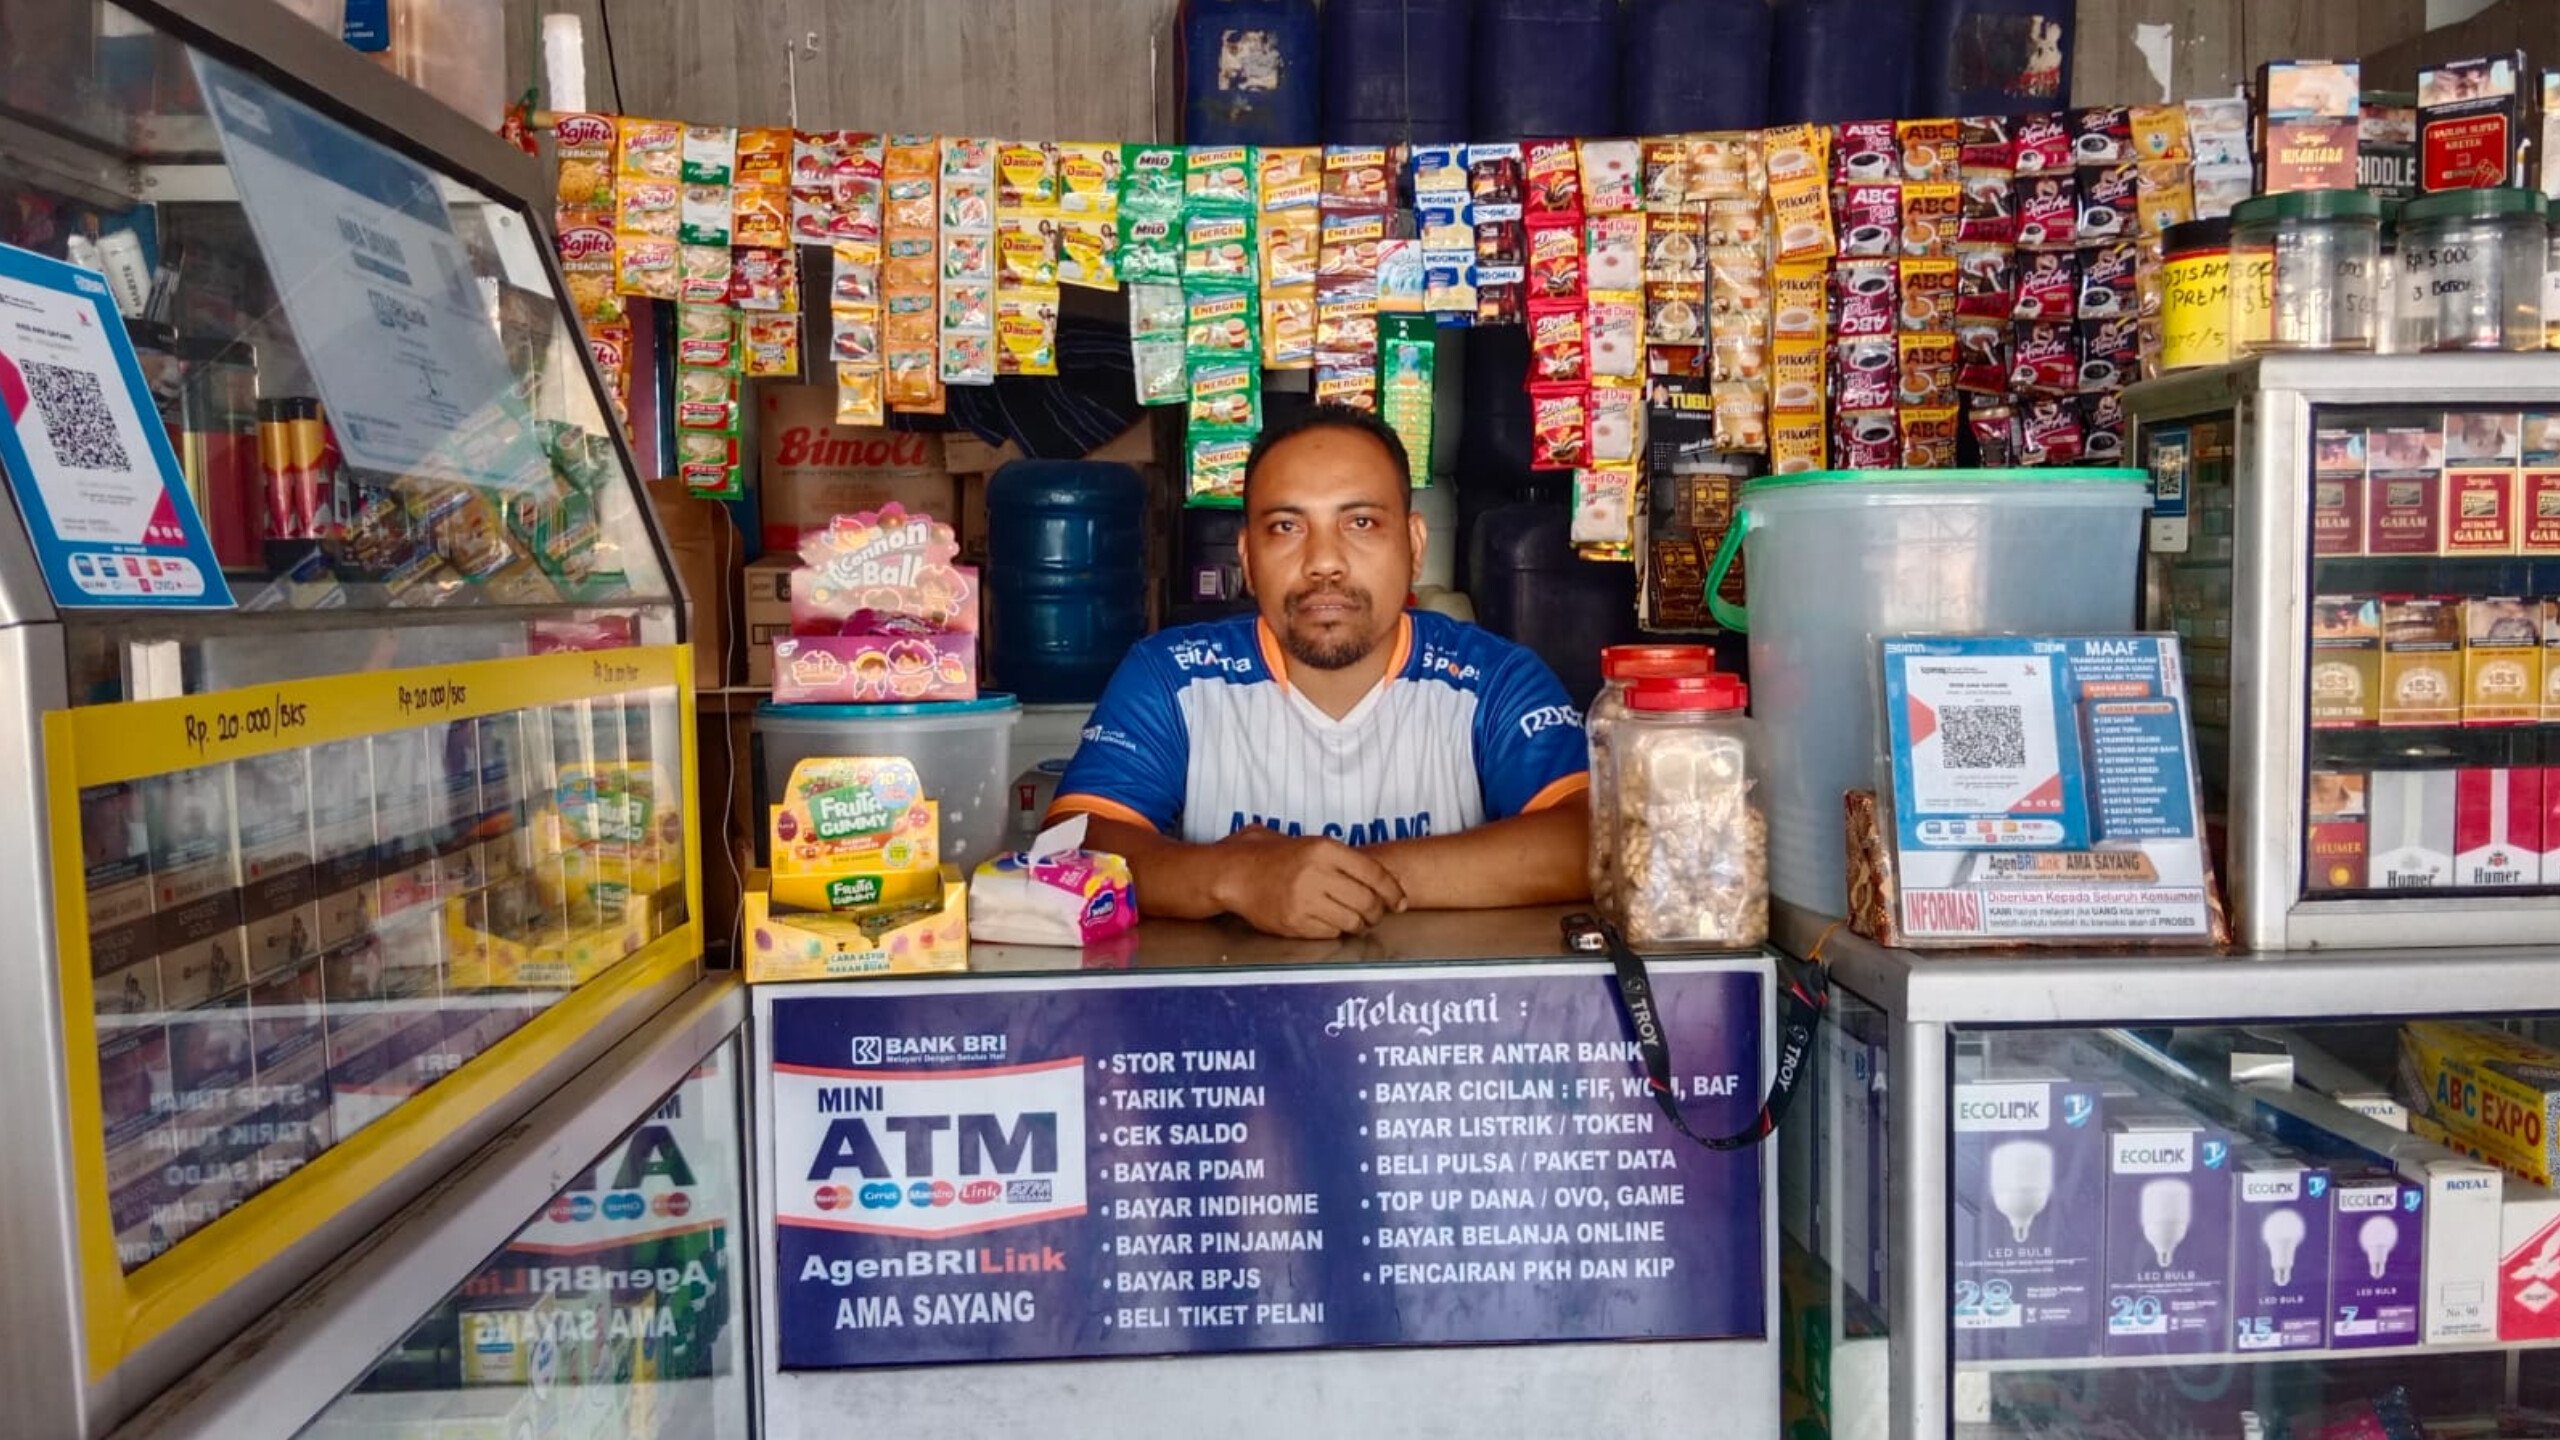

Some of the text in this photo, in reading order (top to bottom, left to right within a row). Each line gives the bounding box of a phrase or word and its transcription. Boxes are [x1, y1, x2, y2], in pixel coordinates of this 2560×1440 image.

[556, 119, 613, 148] Sajiku
[1846, 124, 1890, 136] ABC
[1907, 124, 1955, 141] ABC
[1003, 154, 1045, 168] Dancow
[1139, 154, 1170, 166] MILO
[1192, 150, 1244, 166] ENERGEN
[1330, 152, 1383, 166] ENERGEN
[1421, 195, 1465, 205] INDOMILK
[1853, 188, 1898, 204] ABC
[1908, 198, 1955, 214] ABC
[1135, 223, 1166, 236] MILO
[1192, 225, 1244, 239] ENERGEN
[1326, 224, 1380, 239] ENERGEN
[1616, 221, 1638, 233] Day
[559, 232, 615, 260] Sajiku
[1003, 239, 1045, 253] Dancow
[1426, 255, 1470, 264] INDOMILK
[1907, 273, 1955, 289] ABC
[1193, 301, 1244, 316] ENERGEN
[1324, 302, 1377, 313] ENERGEN
[1613, 306, 1636, 318] Day
[1003, 321, 1044, 336] Dancow
[1905, 347, 1952, 363] ABC
[1195, 375, 1246, 392] ENERGEN
[1905, 421, 1951, 438] ABC
[777, 426, 928, 468] Bimoli
[1605, 475, 1628, 487] Day
[2380, 517, 2428, 528] GARAM
[2454, 530, 2504, 542] GARAM
[863, 553, 924, 587] Ball
[2085, 640, 2140, 657] MAAF
[184, 712, 210, 755] Rp.
[820, 812, 888, 837] GUMMY
[1988, 852, 2141, 875] AgenBRILink AMA SAYANG
[2387, 870, 2437, 888] Humer
[2474, 867, 2521, 884] Humer
[1906, 891, 1980, 932] INFORMASI
[1324, 991, 1500, 1038] Melayani
[1631, 998, 1660, 1048] TROY
[886, 1034, 1007, 1055] BANK BRI
[1374, 1039, 1644, 1067] TRANFER ANTAR BANK
[1113, 1048, 1256, 1075] STOR TUNAI
[1777, 1043, 1801, 1093] TROY
[1113, 1085, 1265, 1111] TARIK TUNAI
[1375, 1080, 1452, 1104] BAYAR
[1460, 1078, 1555, 1102] CICILAN
[1576, 1077, 1616, 1103] FIF,
[1693, 1074, 1740, 1097] BAF
[818, 1086, 884, 1114] MINI
[2437, 1071, 2541, 1147] ABC EXPO
[1960, 1101, 2040, 1120] ECOLINK
[1114, 1122, 1248, 1147] CEK SALDO
[1375, 1112, 1654, 1140] BAYAR LISTRIK TOKEN
[807, 1111, 1059, 1181] ATM
[1377, 1148, 1677, 1177] BELI PULSA PAKET DATA
[2120, 1148, 2185, 1165] ECOLINK
[1115, 1158, 1265, 1184] BAYAR PDAM
[961, 1184, 998, 1200] Link
[2249, 1181, 2295, 1195] ECOLINK
[2446, 1179, 2491, 1192] ROYAL
[1115, 1193, 1320, 1220] BAYAR INDIHOME
[1377, 1183, 1685, 1213] TOP UP DANA OVO, GAME
[2341, 1193, 2394, 1208] ECOLINK
[1116, 1229, 1324, 1257] BAYAR PINJAMAN
[1378, 1220, 1665, 1250] BAYAR BELANJA ONLINE
[1987, 1246, 2053, 1259] LED BULB
[800, 1245, 1067, 1285] AgenBRILink
[1379, 1257, 1676, 1286] PENCAIRAN PKH DAN KIP
[1117, 1268, 1262, 1292] BAYAR BPJS
[2137, 1270, 2196, 1282] LED BULB
[1955, 1279, 2014, 1317] 28
[2258, 1295, 2304, 1305] LED BULB
[2356, 1287, 2398, 1297] LED BULB
[835, 1290, 1036, 1331] AMA SAYANG
[1118, 1301, 1325, 1329] BELI TIKET PELNI
[2110, 1295, 2162, 1326] 20
[2339, 1305, 2359, 1329] 7
[2237, 1316, 2273, 1341] 15
